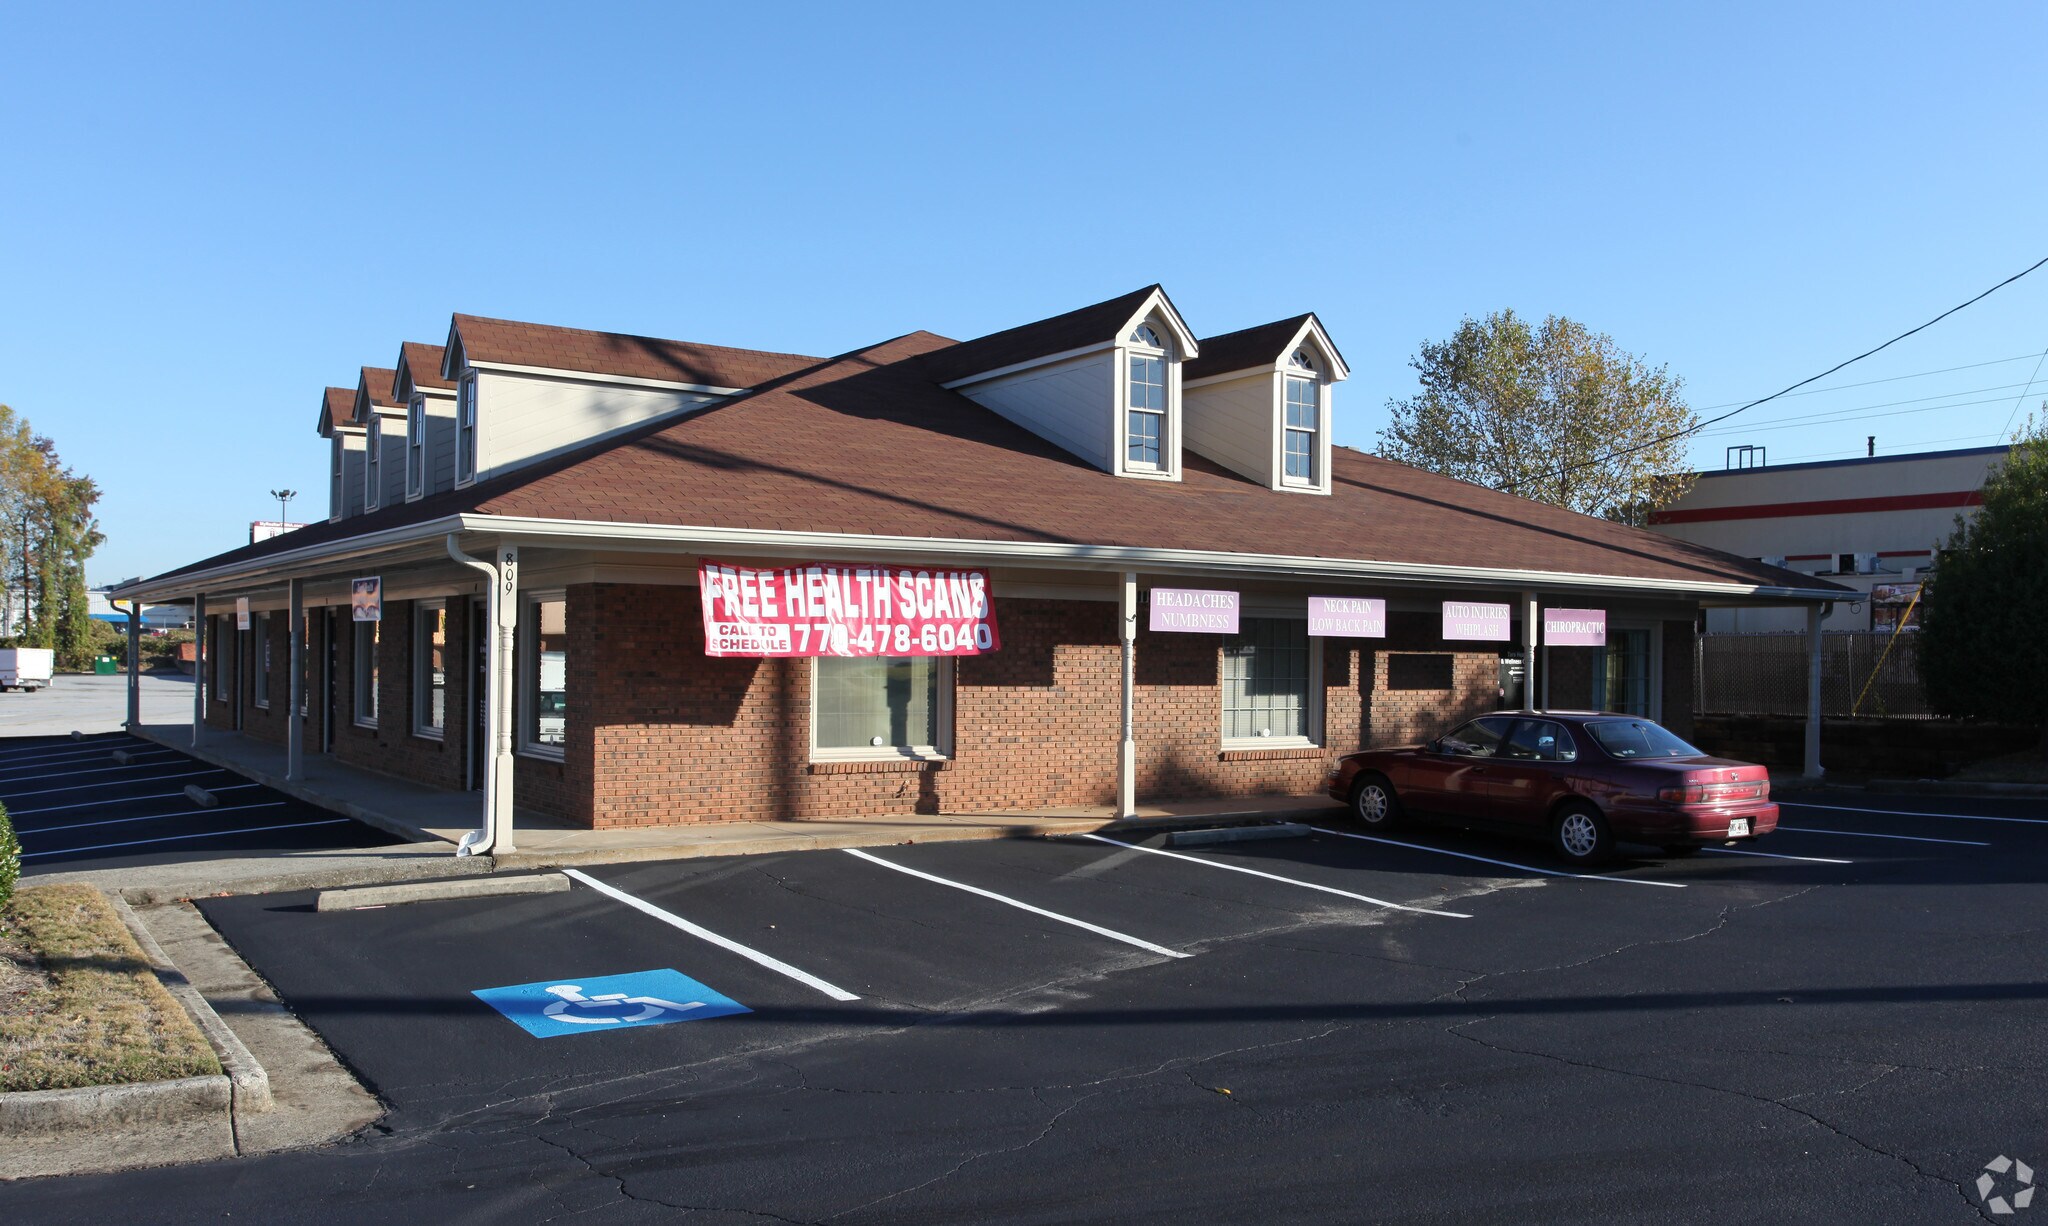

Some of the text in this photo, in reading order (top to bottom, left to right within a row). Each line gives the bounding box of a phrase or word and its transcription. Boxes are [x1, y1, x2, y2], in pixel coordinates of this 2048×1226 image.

[505, 553, 514, 596] 809
[705, 565, 989, 619] FREE HEALTH SCANS
[1156, 592, 1234, 609] HEADACHES
[1324, 600, 1372, 614] NECK PAIN
[1446, 605, 1508, 620] AUTO INJURIES
[1161, 612, 1230, 629] NUMBNESS
[1312, 618, 1383, 633] LOW BACK PAIN
[1545, 620, 1605, 634] CHIROPRACTIC
[719, 625, 777, 637] CALL TO
[794, 623, 993, 651] 770-478-6040
[1455, 623, 1499, 637] WHIPLASH
[712, 638, 788, 650] SCHEDULE
